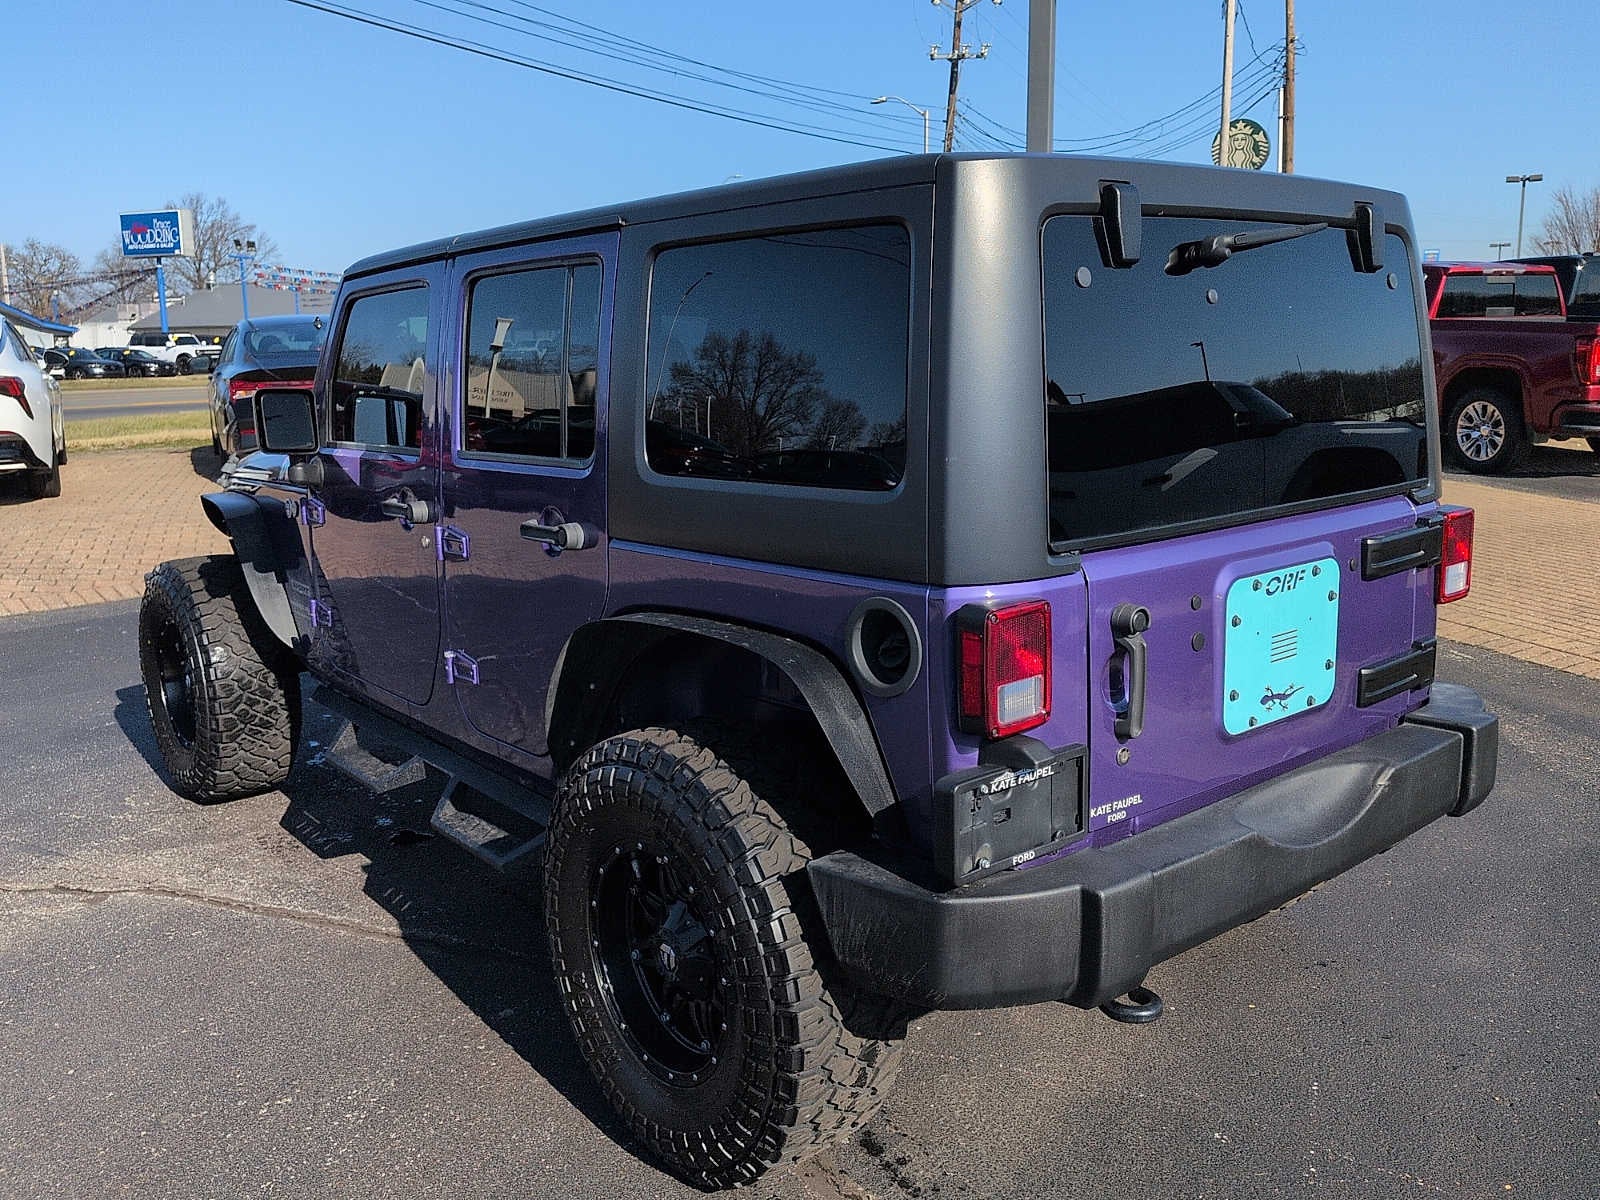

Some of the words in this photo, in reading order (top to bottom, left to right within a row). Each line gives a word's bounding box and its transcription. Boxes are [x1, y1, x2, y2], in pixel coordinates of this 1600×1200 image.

[122, 228, 179, 245] WOODRING
[990, 776, 1017, 794] KATE
[1017, 765, 1055, 785] FAUPEL
[1090, 804, 1112, 818] KATE
[1112, 794, 1143, 812] FAUPEL
[1107, 810, 1127, 824] FORD
[1012, 850, 1036, 866] FORD
